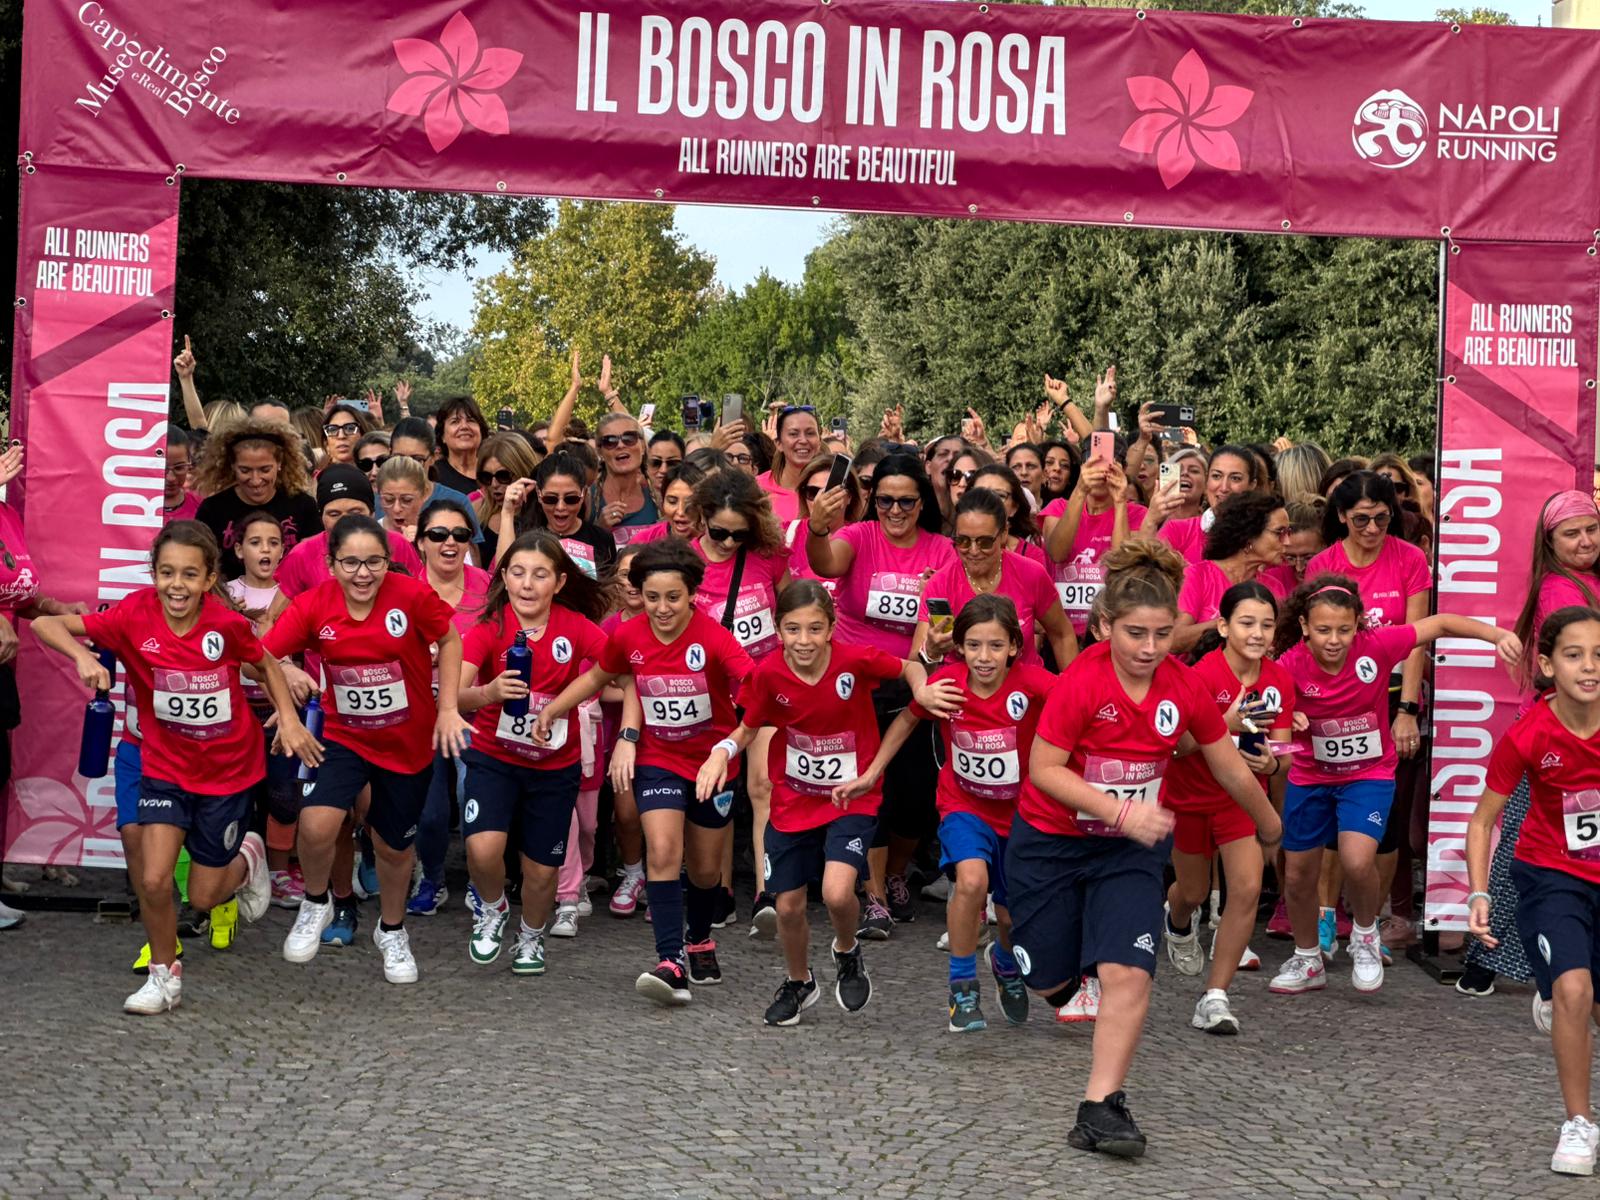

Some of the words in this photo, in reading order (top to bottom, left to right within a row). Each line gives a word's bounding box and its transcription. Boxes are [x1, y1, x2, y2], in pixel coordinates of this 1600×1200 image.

[74, 40, 141, 118] Museo
[164, 46, 227, 118] Bosco
[576, 12, 617, 113] IL
[638, 16, 826, 123] BOSCO
[846, 25, 901, 128] IN
[919, 30, 1066, 136] ROSA
[1438, 102, 1560, 134] NAPOLI
[678, 137, 709, 174] ALL
[715, 139, 807, 178] RUNNERS
[813, 144, 851, 181] ARE
[857, 146, 957, 186] BEAUTIFUL
[1437, 140, 1557, 163] RUNNING
[44, 227, 71, 258] ALL
[75, 228, 150, 263] RUNNERS
[36, 261, 67, 290] ARE
[71, 261, 154, 297] BEAUTIFUL
[1470, 302, 1495, 332] ALL
[1499, 304, 1572, 335] RUNNERS
[1463, 336, 1494, 365] ARE
[1498, 337, 1578, 368] BEAUTIFUL
[101, 382, 170, 528] ROSA
[1437, 448, 1502, 594] ROSA
[879, 595, 918, 618] 839
[1066, 586, 1096, 604] 918
[192, 674, 218, 683] BOSCO
[362, 676, 370, 684] IN
[371, 673, 392, 682] ROSA
[363, 667, 388, 677] BOSCO
[189, 683, 198, 691] IN
[200, 682, 220, 691] ROSA
[678, 685, 696, 693] ROSA
[168, 696, 218, 719] 936
[347, 688, 393, 710] 935
[653, 699, 699, 721] 954
[1344, 718, 1367, 727] BOSCO
[1351, 723, 1370, 732] ROSA
[814, 745, 822, 753] IN
[823, 744, 845, 752] ROSA
[816, 738, 842, 746] BOSCO
[975, 742, 983, 750] IN
[985, 741, 1006, 750] ROSA
[1325, 736, 1369, 758] 953
[797, 755, 843, 780] 932
[958, 752, 1006, 779] 930
[1576, 814, 1600, 841] 5
